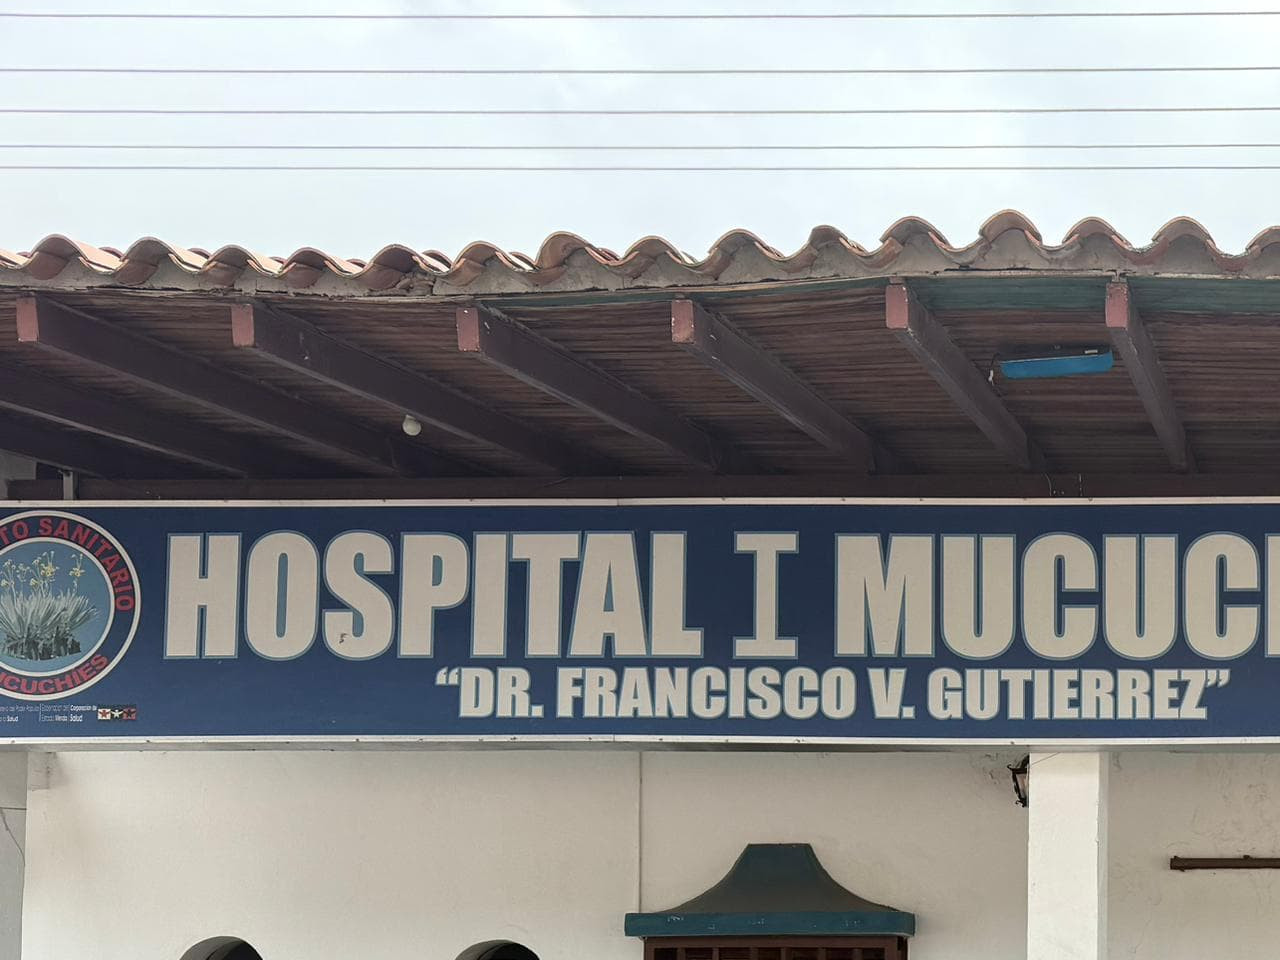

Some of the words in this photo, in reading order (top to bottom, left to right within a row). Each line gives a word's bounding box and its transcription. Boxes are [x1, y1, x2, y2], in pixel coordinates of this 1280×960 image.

[38, 517, 135, 612] SANITARIO
[164, 530, 704, 661] HOSPITAL
[733, 530, 799, 660] I
[0, 654, 109, 694] CUCHIES
[556, 666, 857, 720] FRANCISCO
[867, 667, 915, 719] V.
